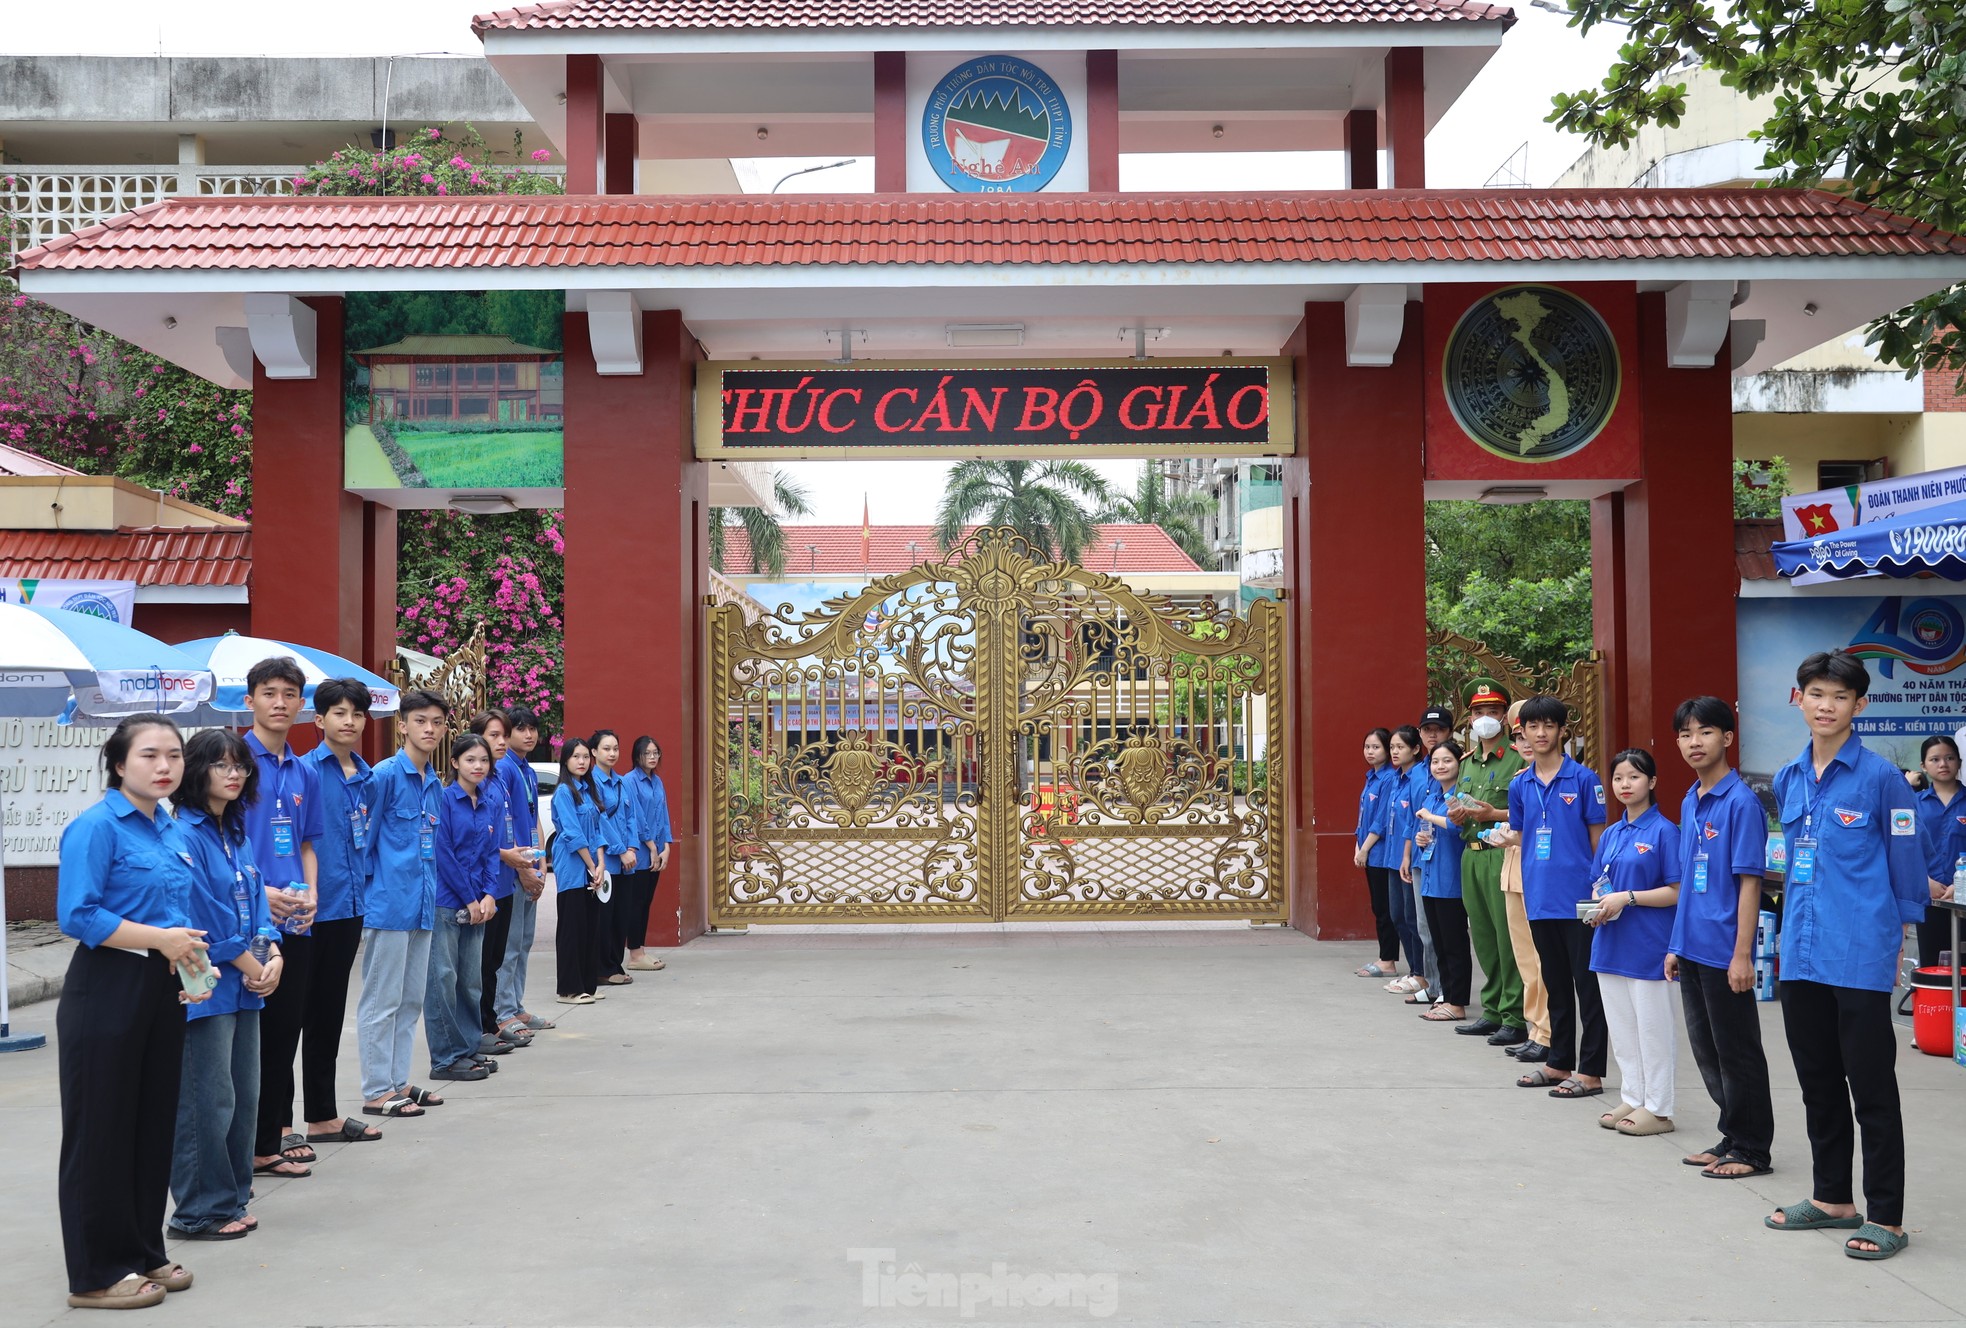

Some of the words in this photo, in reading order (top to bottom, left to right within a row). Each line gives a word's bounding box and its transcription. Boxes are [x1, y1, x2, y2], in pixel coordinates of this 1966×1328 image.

[1048, 96, 1064, 124] THPT
[950, 156, 1005, 179] Nghệ
[1009, 157, 1040, 175] An
[874, 375, 1007, 433] CÁN
[1014, 380, 1103, 440] BỘ
[1119, 373, 1268, 431] GIÁO
[1868, 490, 1891, 509] ĐOÀN
[1892, 486, 1920, 504] THANH
[1921, 480, 1943, 499] NIÊN
[1841, 549, 1858, 557] Giving
[120, 673, 196, 691] mobifone
[1902, 680, 1916, 690] 40
[1919, 678, 1946, 690] NĂM
[1867, 691, 1903, 703] TRƯỜNG
[1905, 693, 1926, 703] THPT
[1929, 691, 1948, 703] DÂN
[1921, 705, 1952, 715] (1984
[1858, 720, 1877, 732] BẢN
[1878, 719, 1897, 732] SẮC
[1905, 719, 1926, 732] KIẾN
[1928, 721, 1946, 734] TẠO
[34, 765, 93, 793] THPT
[52, 809, 69, 826] TP
